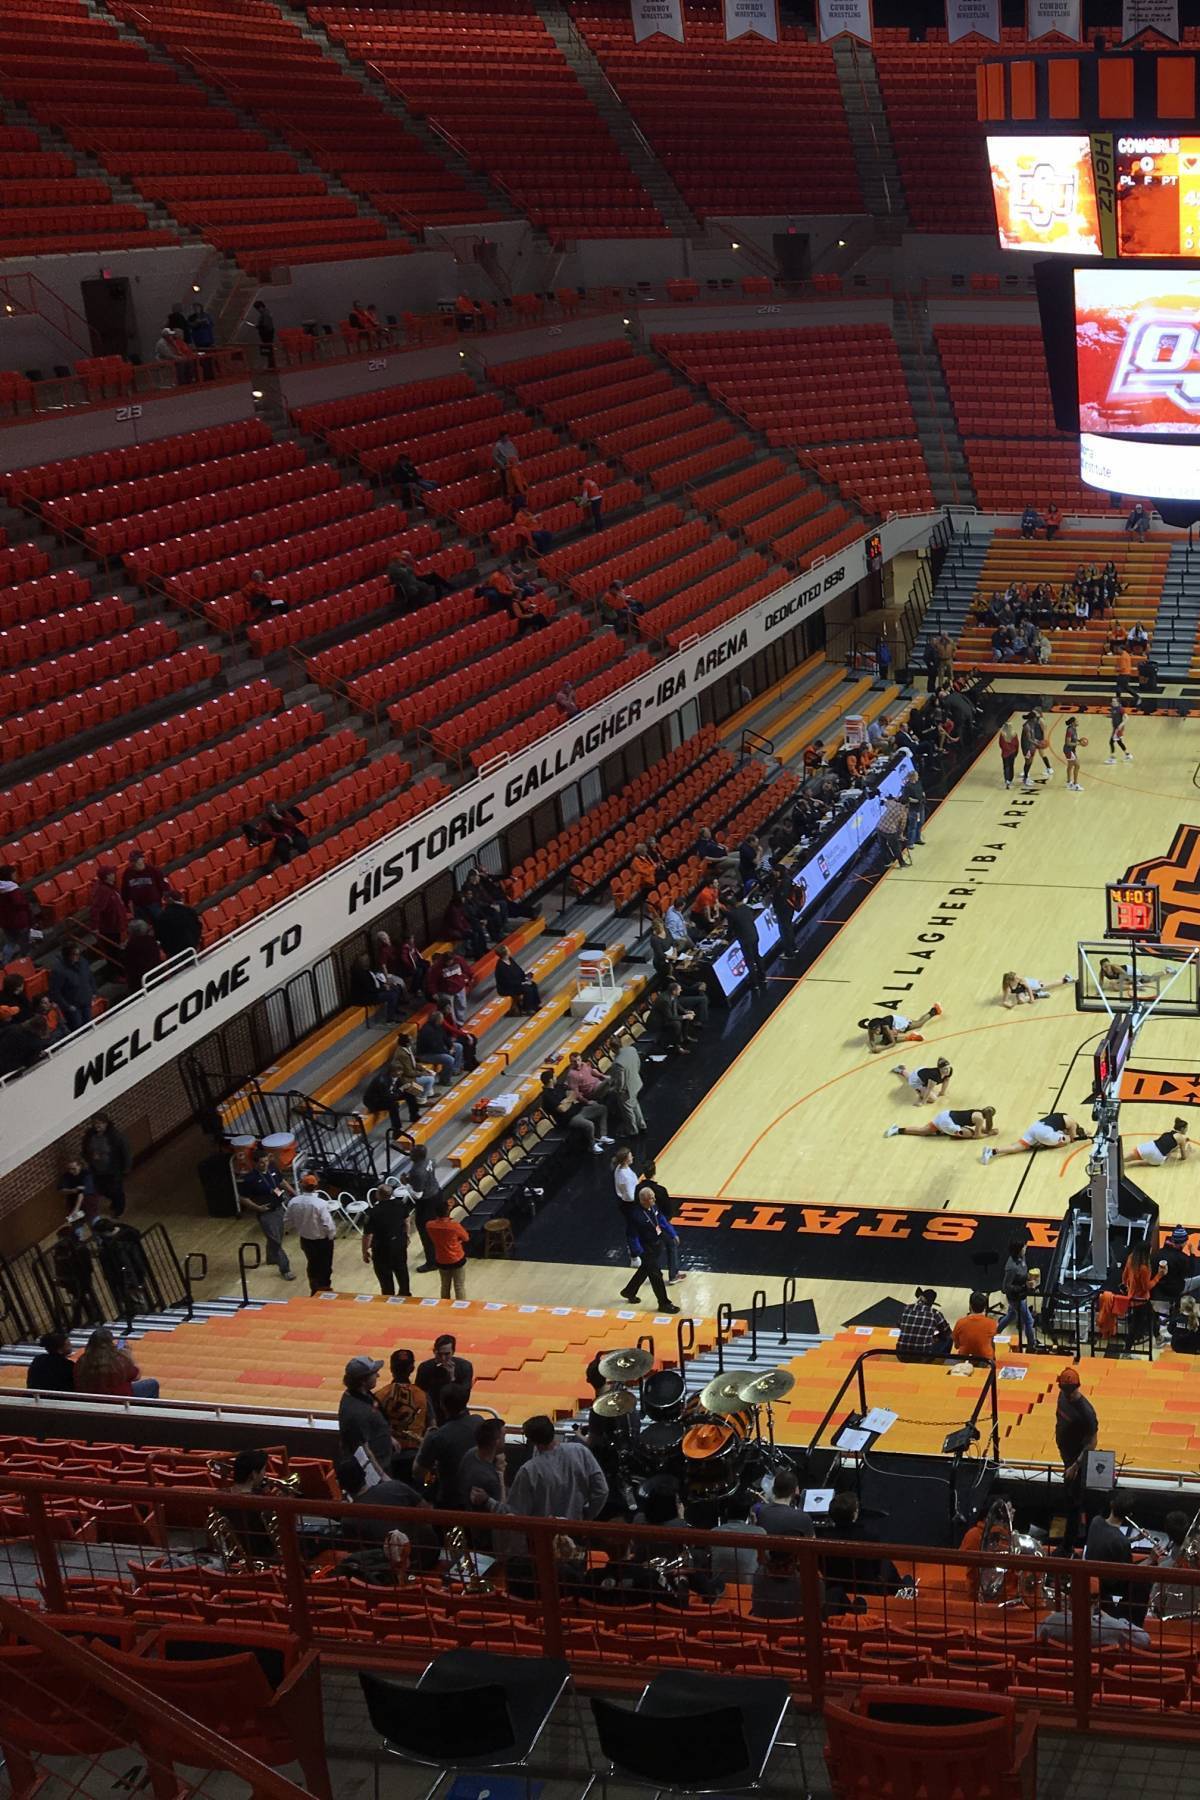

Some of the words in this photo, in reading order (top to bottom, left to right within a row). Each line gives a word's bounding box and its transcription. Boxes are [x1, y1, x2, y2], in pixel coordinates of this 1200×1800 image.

[1094, 139, 1114, 213] Hertz
[1140, 156, 1154, 172] 0
[1161, 176, 1178, 186] PT
[115, 405, 143, 421] 213
[997, 778, 1048, 829] ARENA
[74, 955, 251, 1098] WELCOME
[259, 924, 303, 969] TO
[349, 792, 496, 916] HISTORIC
[504, 669, 688, 808] GALLAGHER-IBA
[694, 628, 748, 682] ARENA
[764, 583, 821, 632] DEDICATED
[823, 566, 846, 592] 1938
[670, 1202, 979, 1243] STATE
